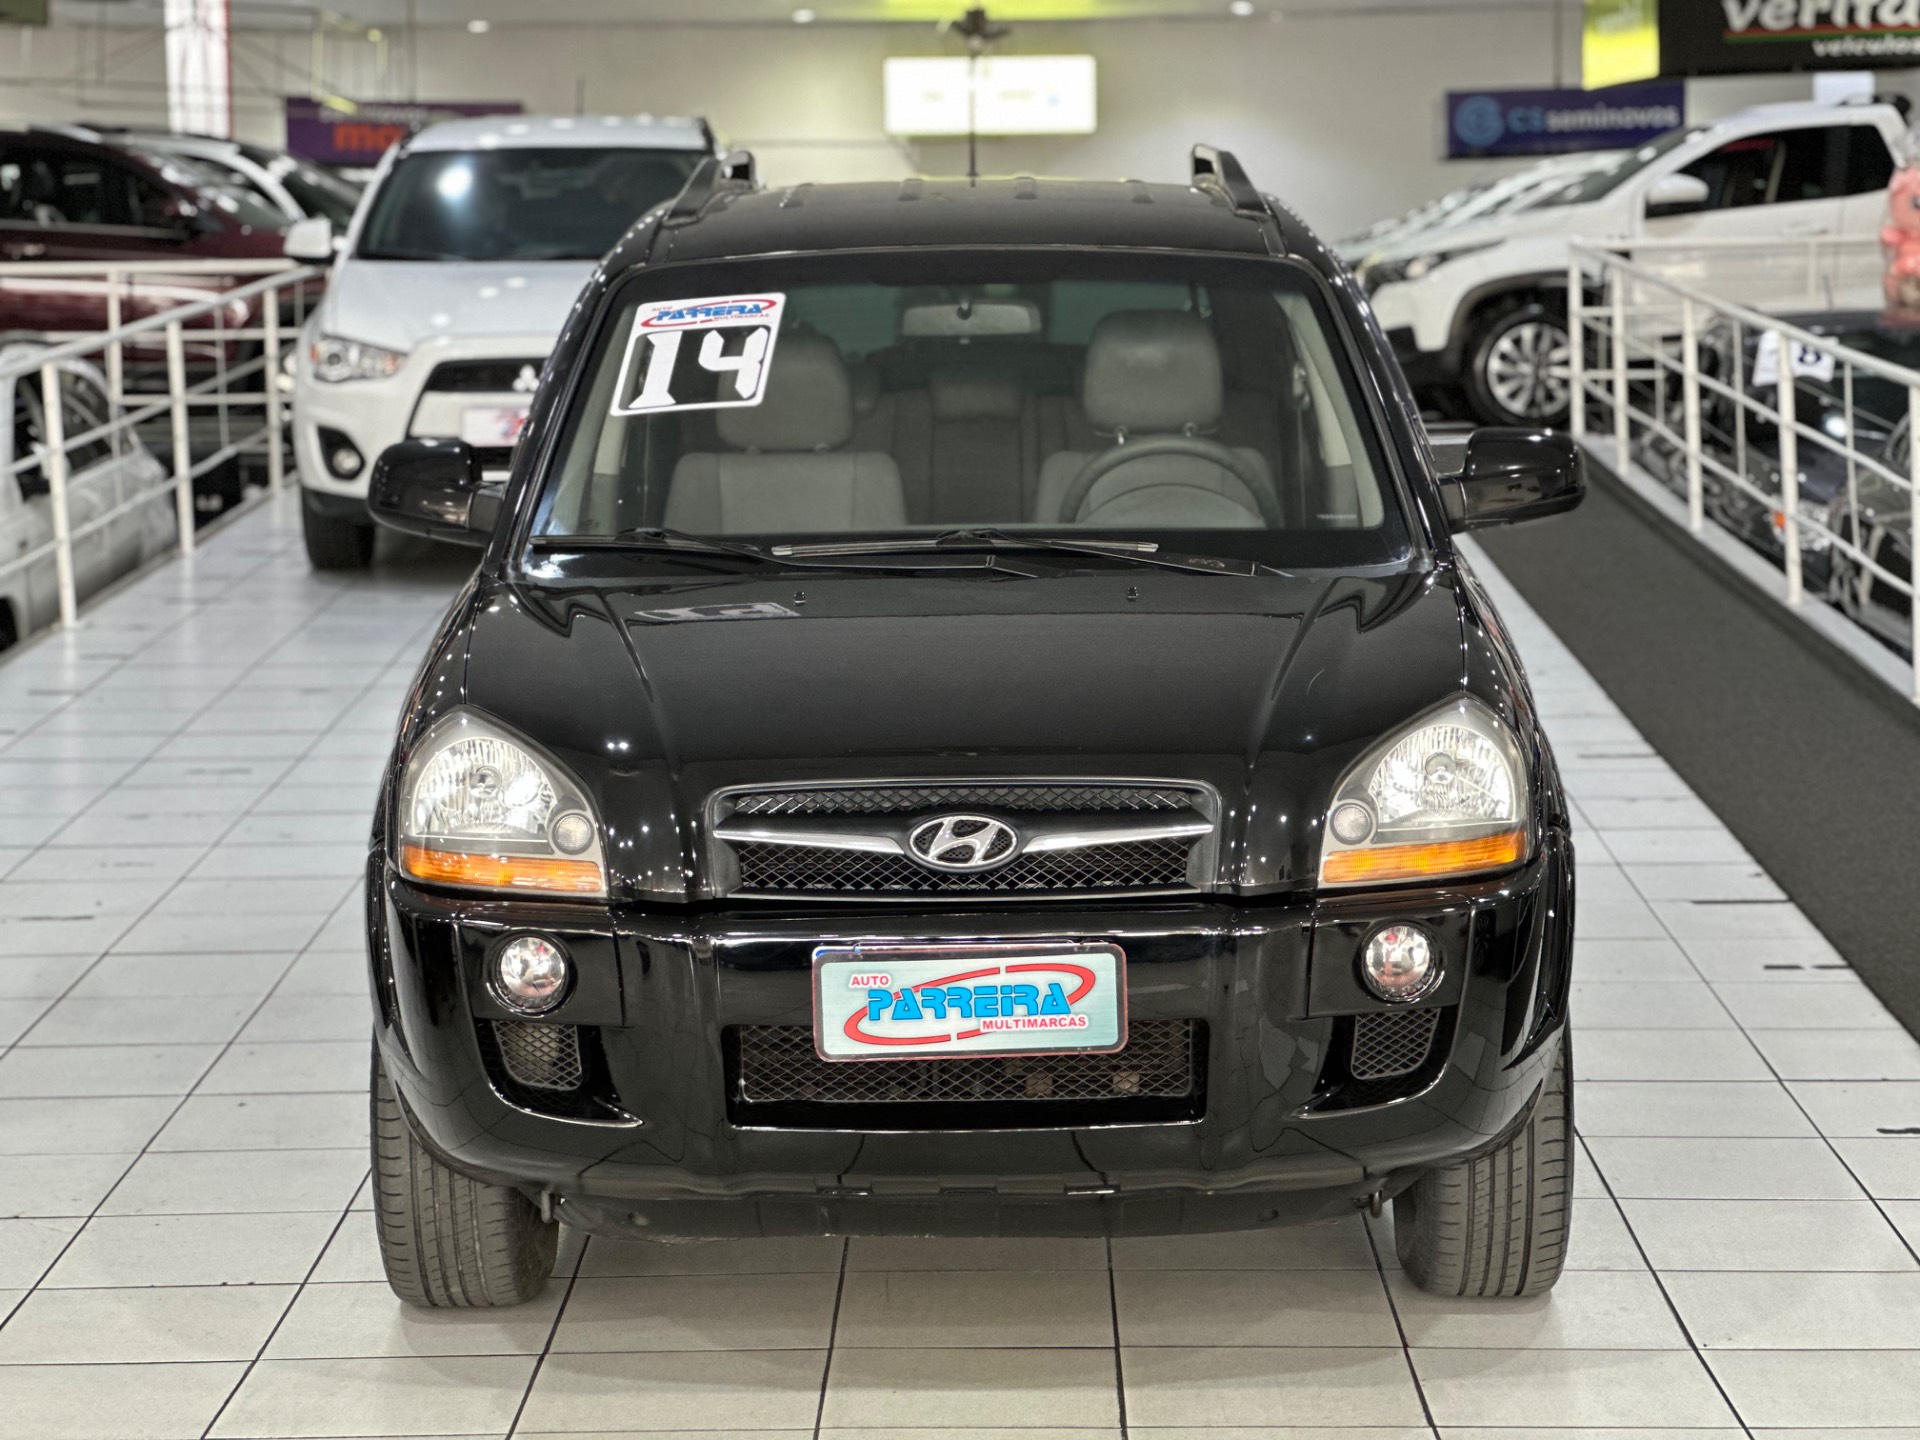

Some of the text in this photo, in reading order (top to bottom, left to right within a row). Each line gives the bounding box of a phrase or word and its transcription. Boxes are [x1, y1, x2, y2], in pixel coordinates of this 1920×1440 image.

[656, 304, 762, 321] PARREIRA
[628, 327, 769, 409] 14
[850, 975, 890, 987] AUTO
[868, 983, 1071, 1021] PARREIRA
[982, 1016, 1087, 1031] MULTIMARCAS
